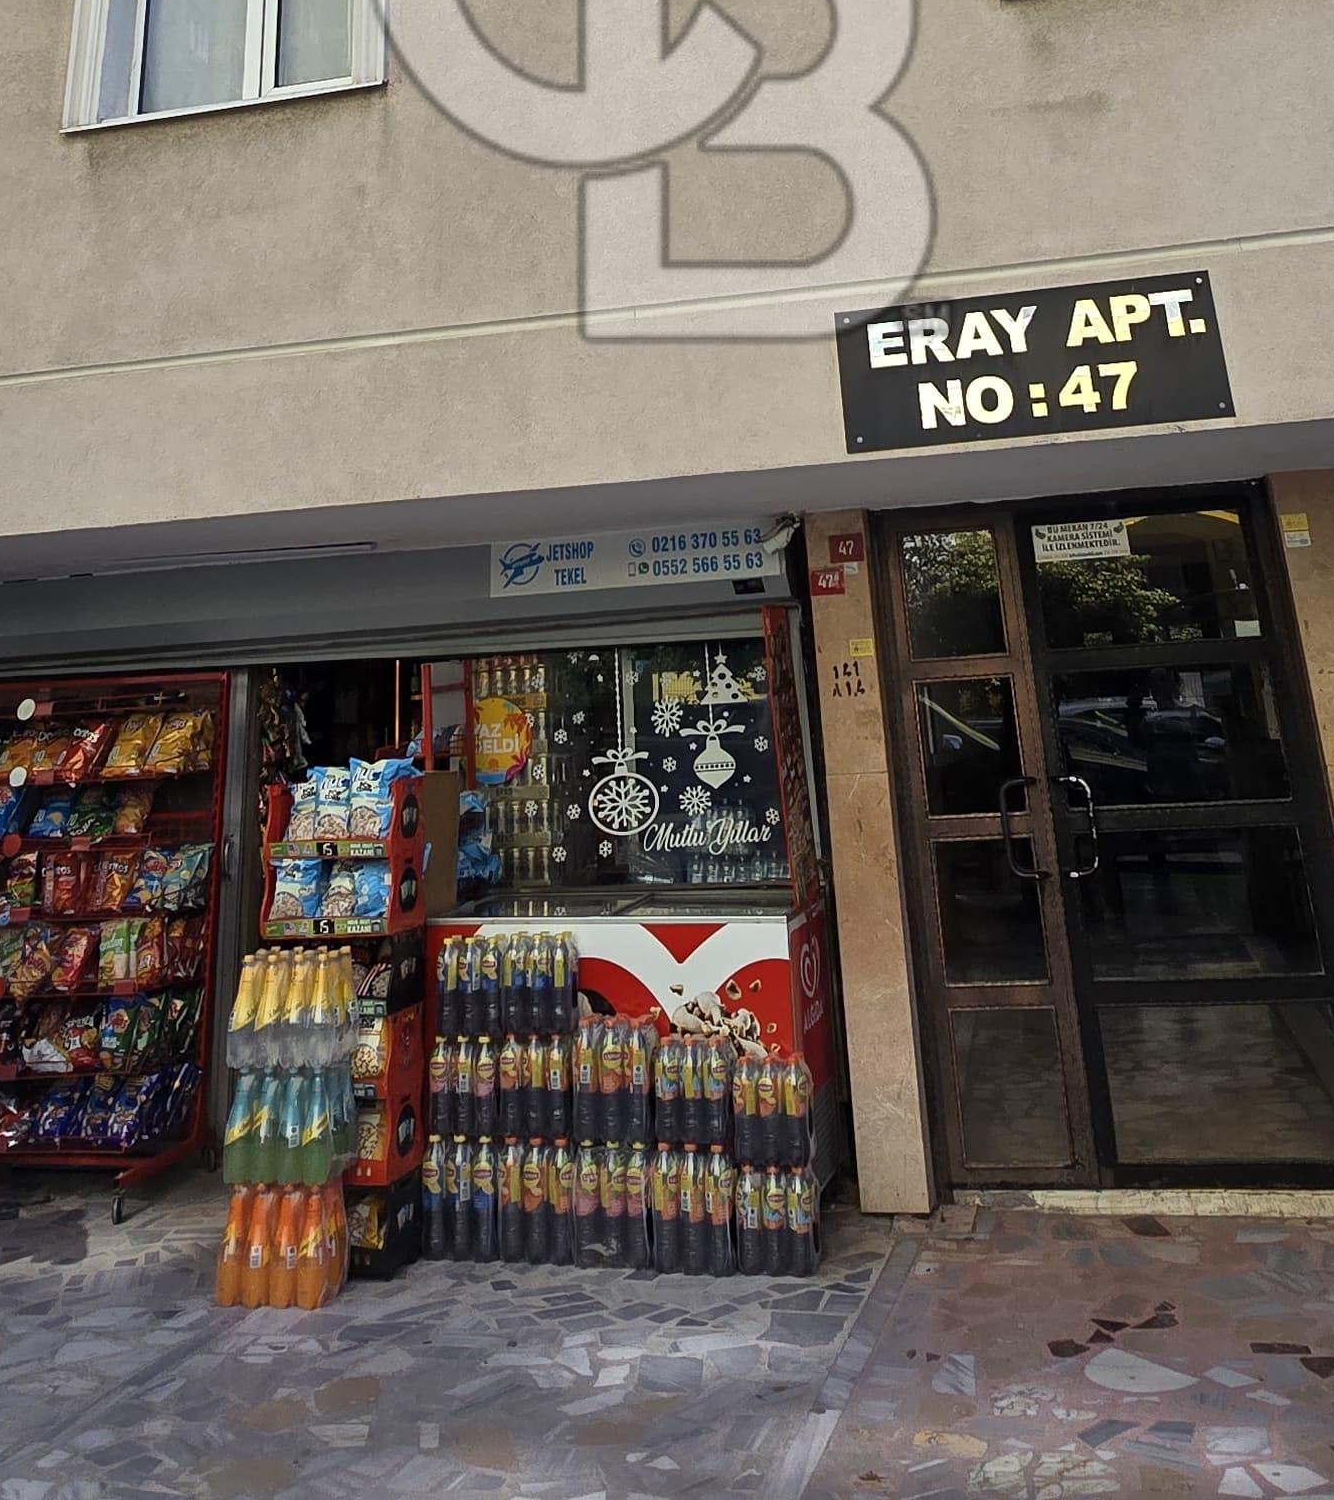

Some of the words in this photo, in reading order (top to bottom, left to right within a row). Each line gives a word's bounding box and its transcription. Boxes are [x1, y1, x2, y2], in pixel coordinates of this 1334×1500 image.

[867, 305, 1037, 369] ERAY
[1066, 289, 1207, 348] APT.
[545, 540, 594, 563] JETSHOP
[651, 534, 685, 553] 0216
[691, 532, 717, 550] 370
[722, 530, 740, 548] 55
[744, 528, 762, 545] 63
[838, 540, 855, 557] 47
[652, 559, 688, 577] 0552
[692, 556, 719, 574] 566
[723, 555, 741, 571] 55
[745, 552, 764, 570] 63
[554, 568, 587, 587] TEKEL
[643, 823, 706, 852] Mutlu
